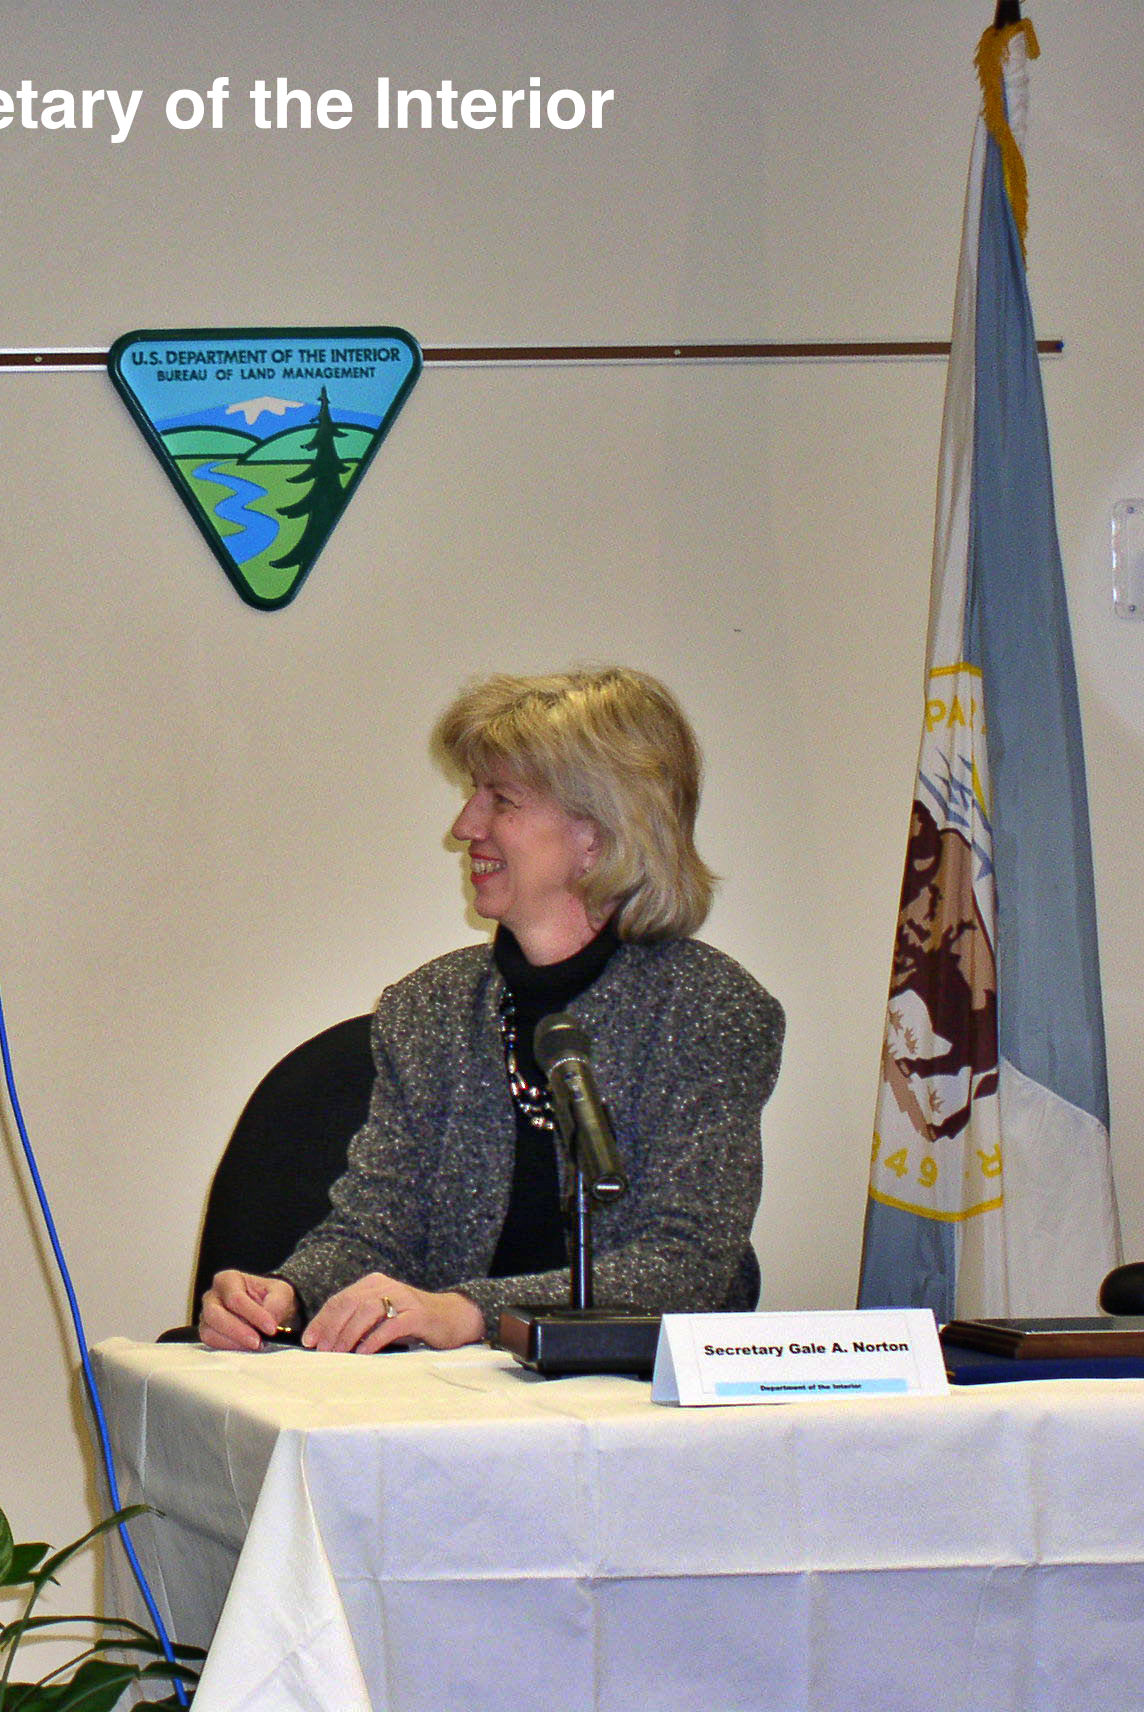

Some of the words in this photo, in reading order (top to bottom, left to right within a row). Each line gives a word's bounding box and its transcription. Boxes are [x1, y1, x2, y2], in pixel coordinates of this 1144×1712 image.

[131, 351, 162, 366] U.S.
[166, 349, 266, 366] DEPARTMENT
[271, 349, 294, 364] OF
[298, 348, 326, 363] THE
[331, 347, 401, 363] INTERIOR
[157, 369, 207, 382] BUREAU
[216, 369, 233, 381] OF
[240, 368, 276, 380] LAND
[282, 366, 376, 380] MANAGEMENT
[704, 1344, 784, 1358] Secretary
[789, 1343, 826, 1356] Gale
[832, 1342, 848, 1354] A.
[853, 1341, 909, 1353] Norton
[759, 1384, 806, 1392] Department
